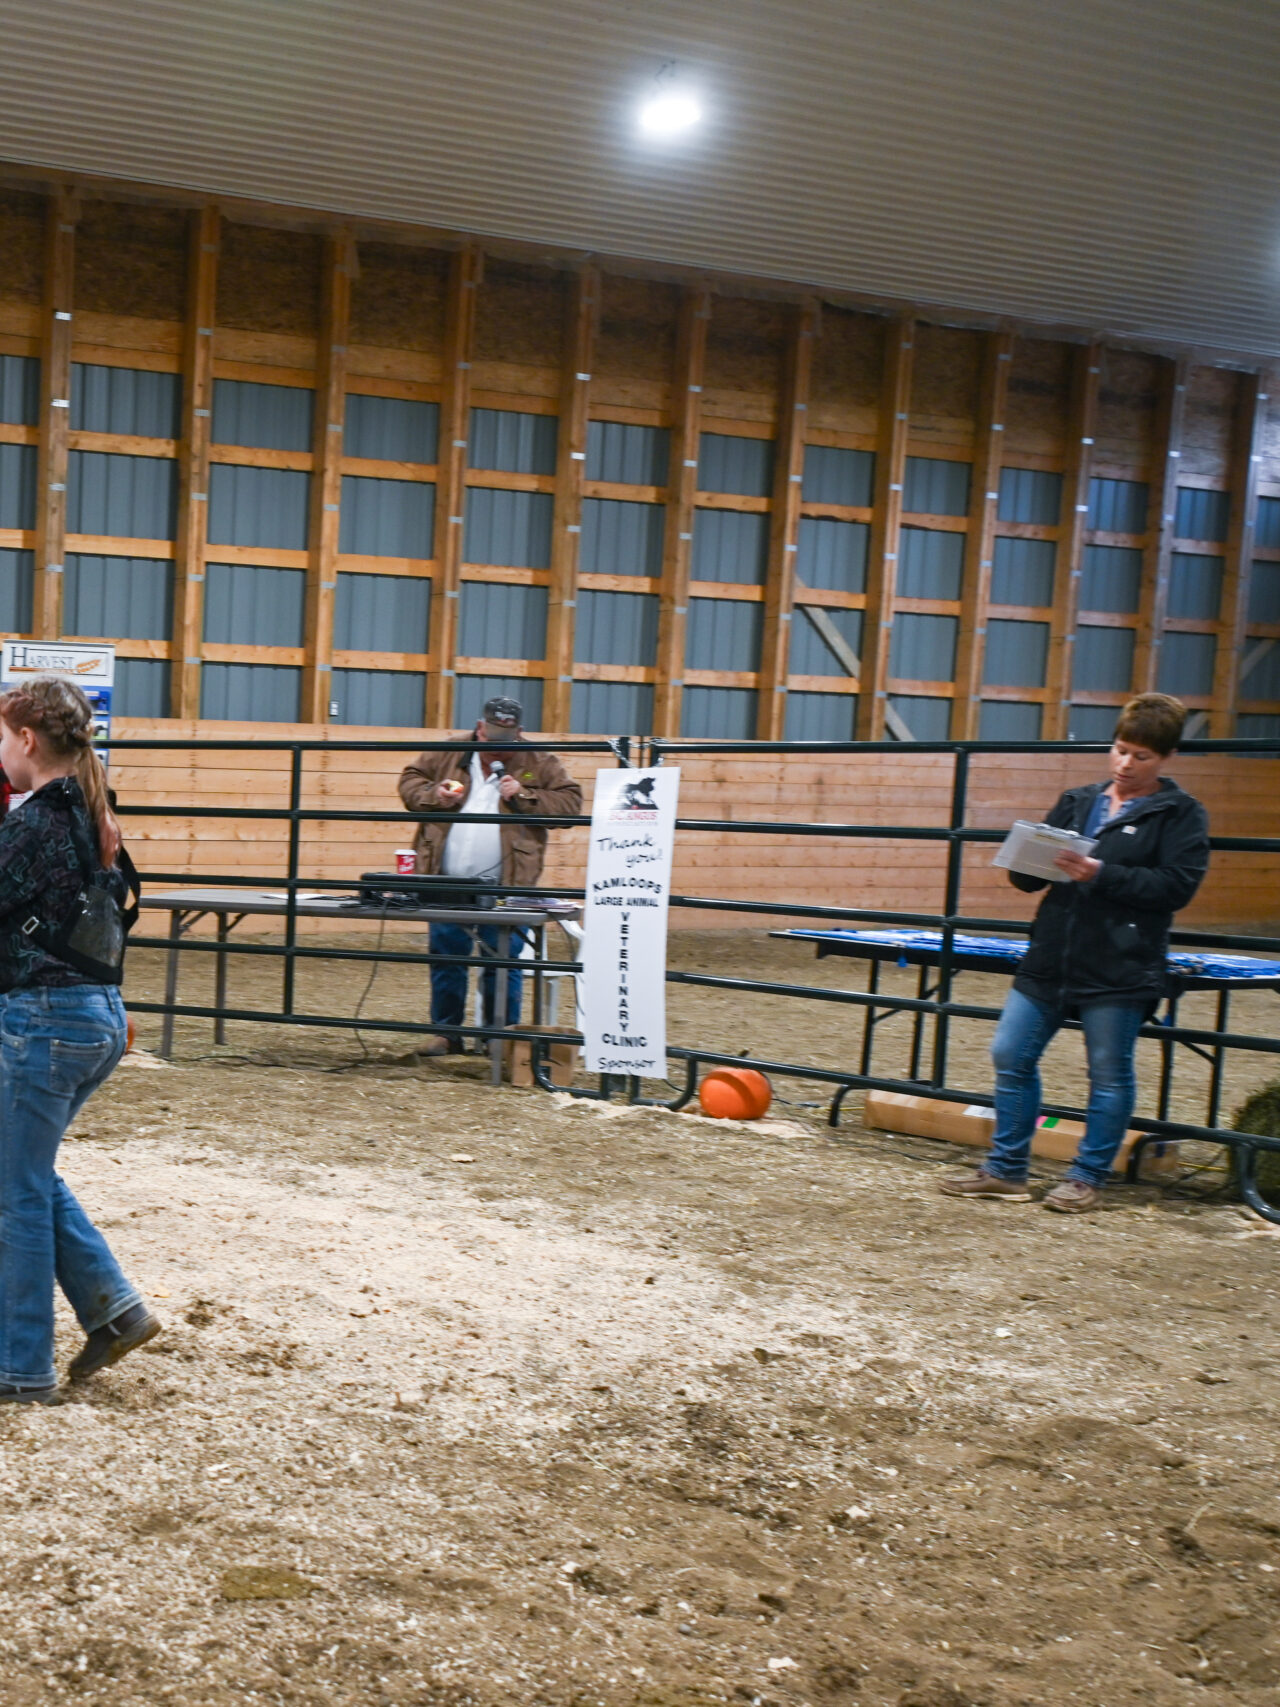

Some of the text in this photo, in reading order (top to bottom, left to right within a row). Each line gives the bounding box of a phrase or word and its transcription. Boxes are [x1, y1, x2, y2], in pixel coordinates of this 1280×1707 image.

[10, 646, 74, 669] HARVEST
[596, 833, 654, 852] Thank
[592, 877, 662, 894] KAMLOOPS
[594, 896, 659, 907] LARGE ANIMAL
[618, 911, 630, 1032] VETERINARY
[601, 1033, 648, 1047] CLINIC
[598, 1057, 657, 1071] Sponsor
